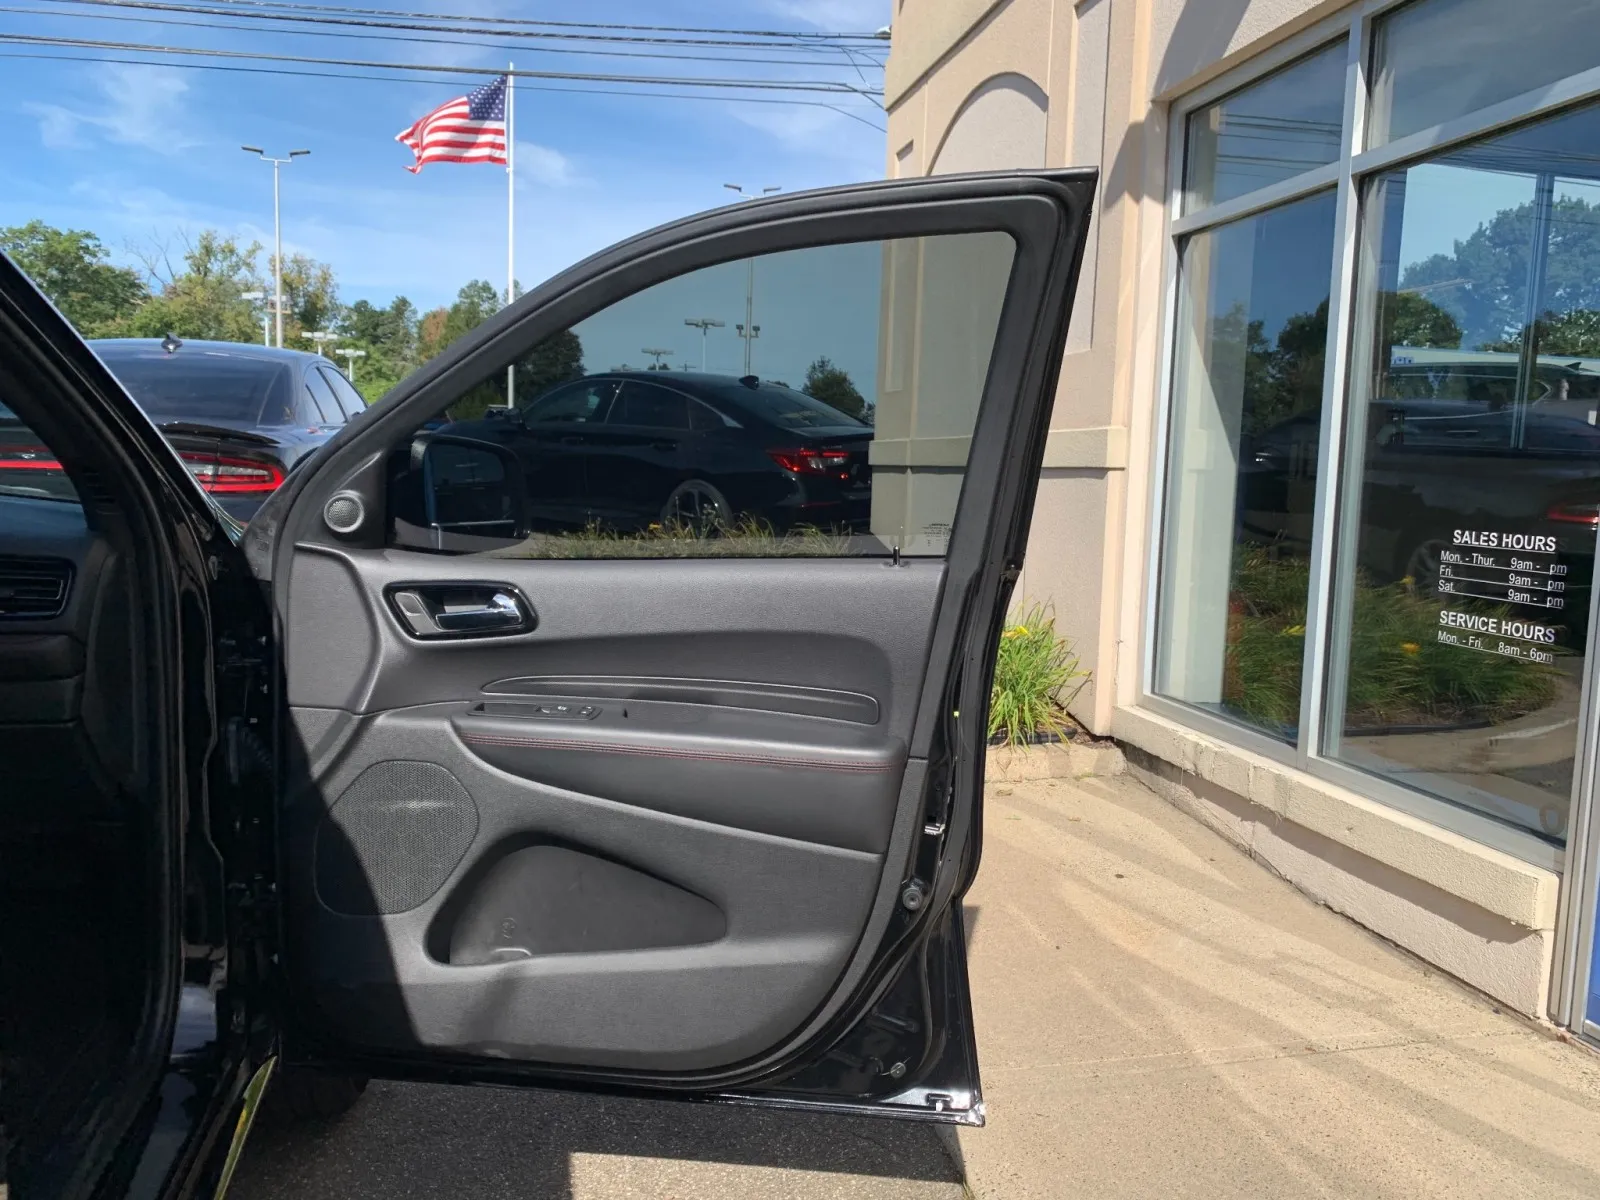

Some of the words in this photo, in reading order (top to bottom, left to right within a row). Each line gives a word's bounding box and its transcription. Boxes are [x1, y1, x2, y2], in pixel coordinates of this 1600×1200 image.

[1453, 529, 1498, 546] SALES
[1502, 533, 1556, 551] HOURS
[1440, 550, 1463, 562] Mon.
[1472, 553, 1495, 566] Thur.
[1510, 558, 1533, 570] 9am
[1550, 563, 1567, 575] pm
[1439, 565, 1453, 577] Fri.
[1509, 573, 1531, 586] 9am
[1547, 580, 1565, 592] pm
[1438, 579, 1455, 592] Sat.
[1507, 589, 1530, 602] 9am
[1546, 596, 1564, 608] pm
[1439, 610, 1497, 633] SERVICE
[1501, 621, 1555, 643] HOURS
[1437, 630, 1459, 645] Mon.
[1468, 636, 1483, 649] Fri.
[1498, 641, 1520, 656] 8am
[1529, 648, 1553, 663] 6pm
